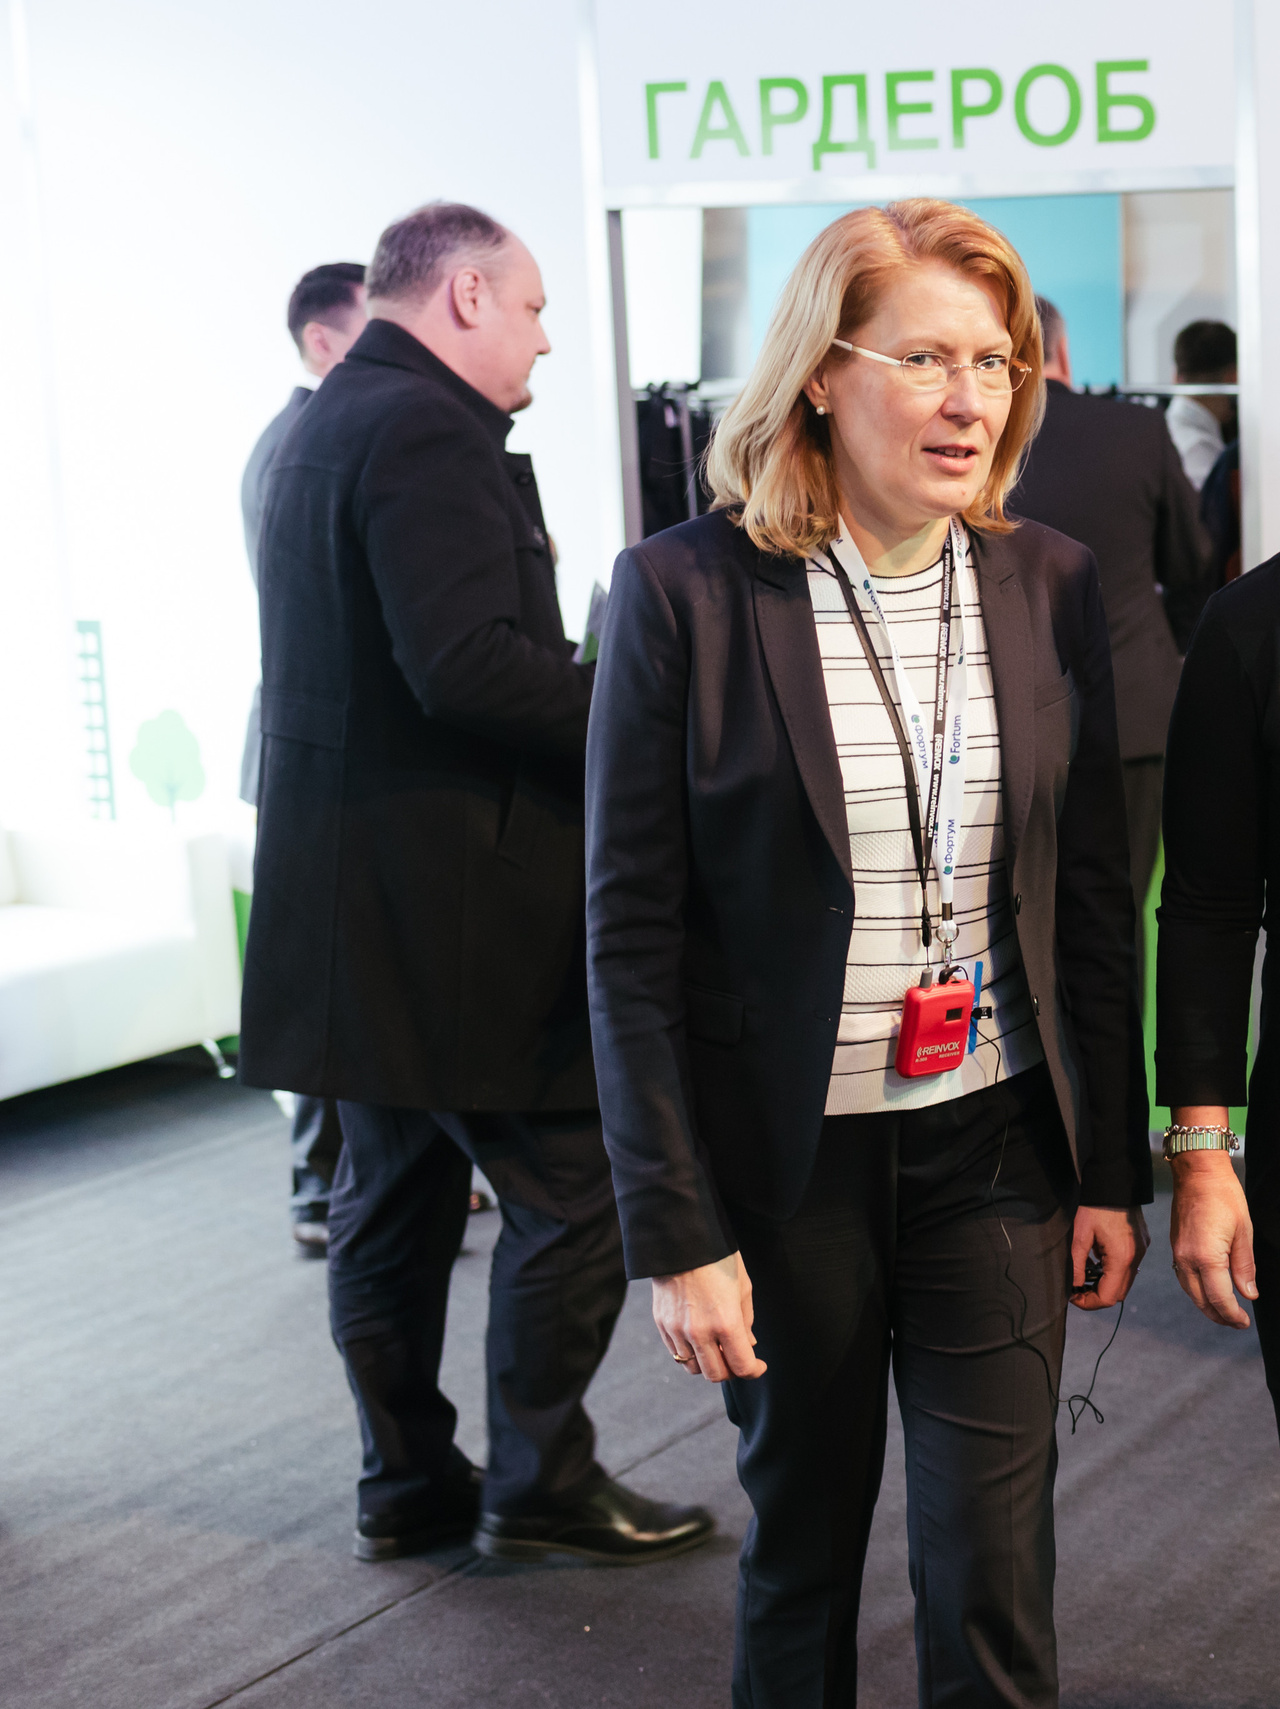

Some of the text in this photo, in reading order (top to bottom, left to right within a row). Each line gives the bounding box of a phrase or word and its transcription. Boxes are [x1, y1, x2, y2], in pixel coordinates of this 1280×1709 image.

[644, 59, 1157, 172] ГАРДЕРОБ
[943, 552, 951, 611] www.reinvox.ru
[936, 660, 947, 721] www.reinvox.ru
[916, 724, 928, 769] Фортум
[950, 714, 962, 754] Fortum
[927, 773, 940, 838] www.reinvox.ru
[943, 818, 955, 864] Фортум
[922, 1041, 960, 1056] REINVOX
